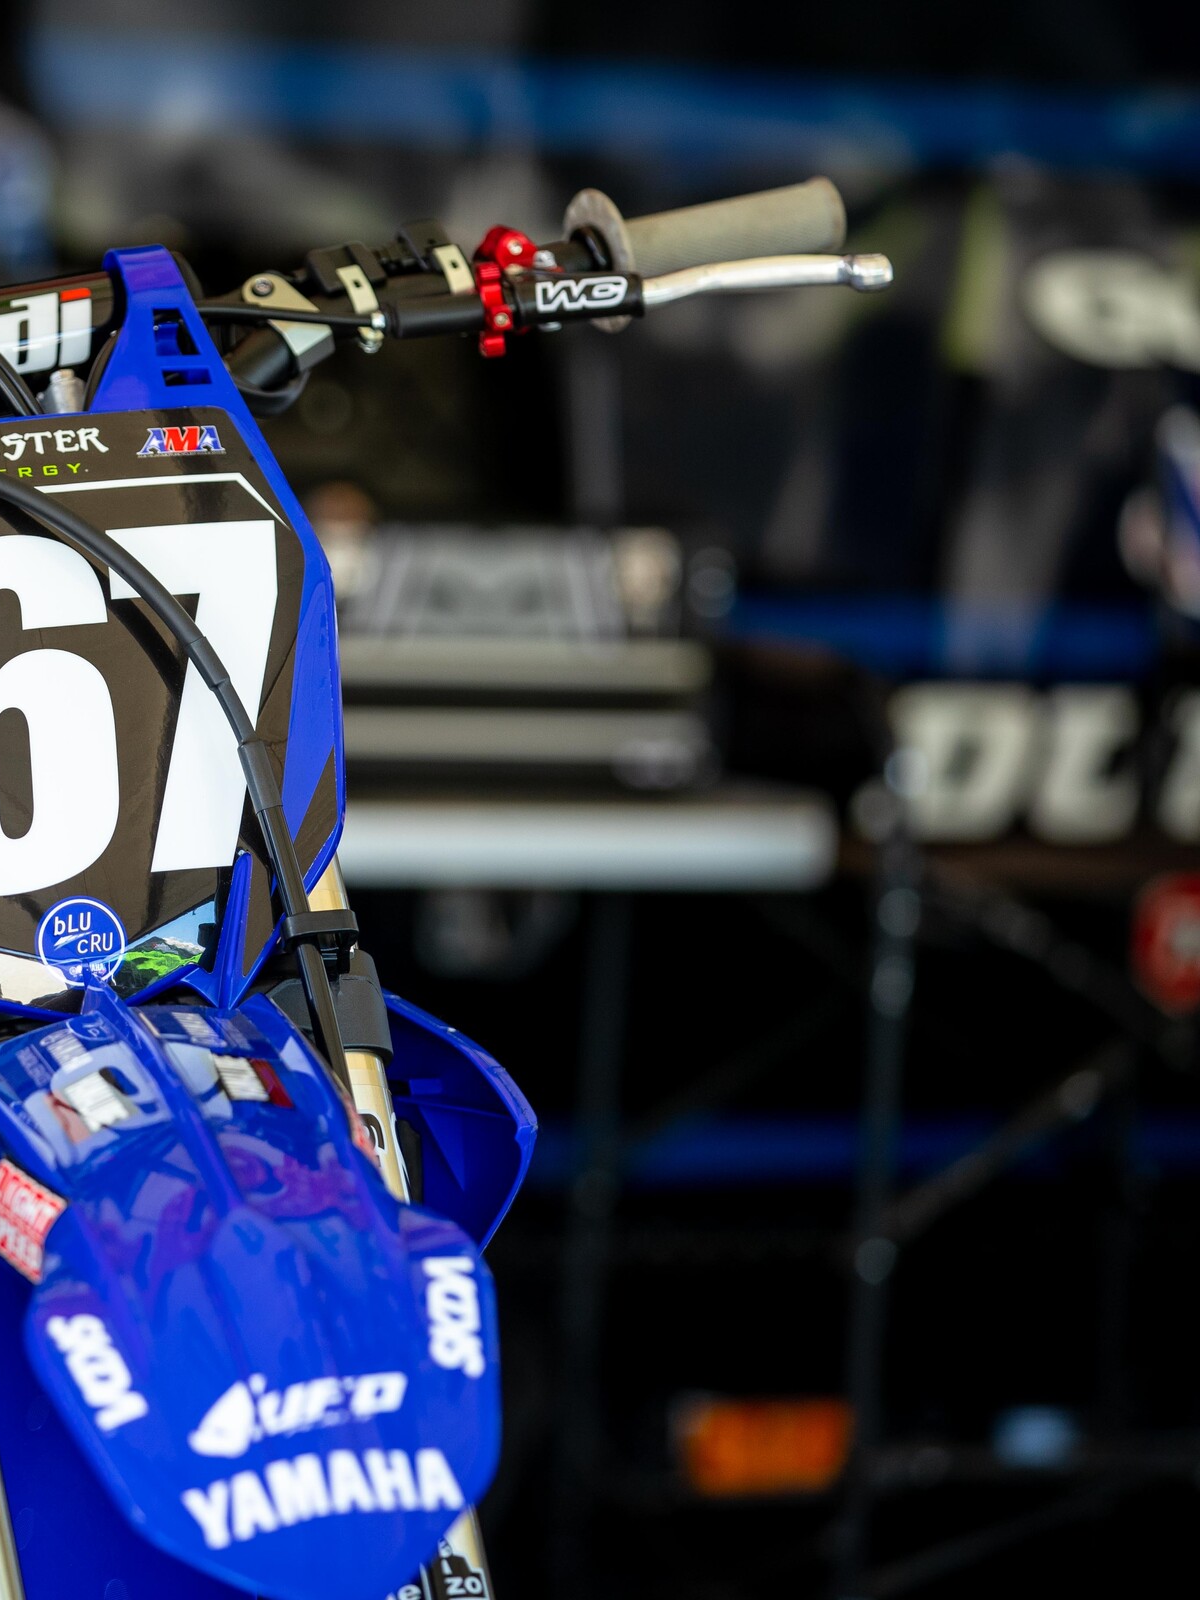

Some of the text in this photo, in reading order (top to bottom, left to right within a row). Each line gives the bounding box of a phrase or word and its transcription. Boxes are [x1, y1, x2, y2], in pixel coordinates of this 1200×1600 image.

[136, 425, 225, 455] AMA
[54, 911, 91, 936] bLU
[77, 932, 113, 954] cRU
[179, 1447, 467, 1550] YAMAHA
